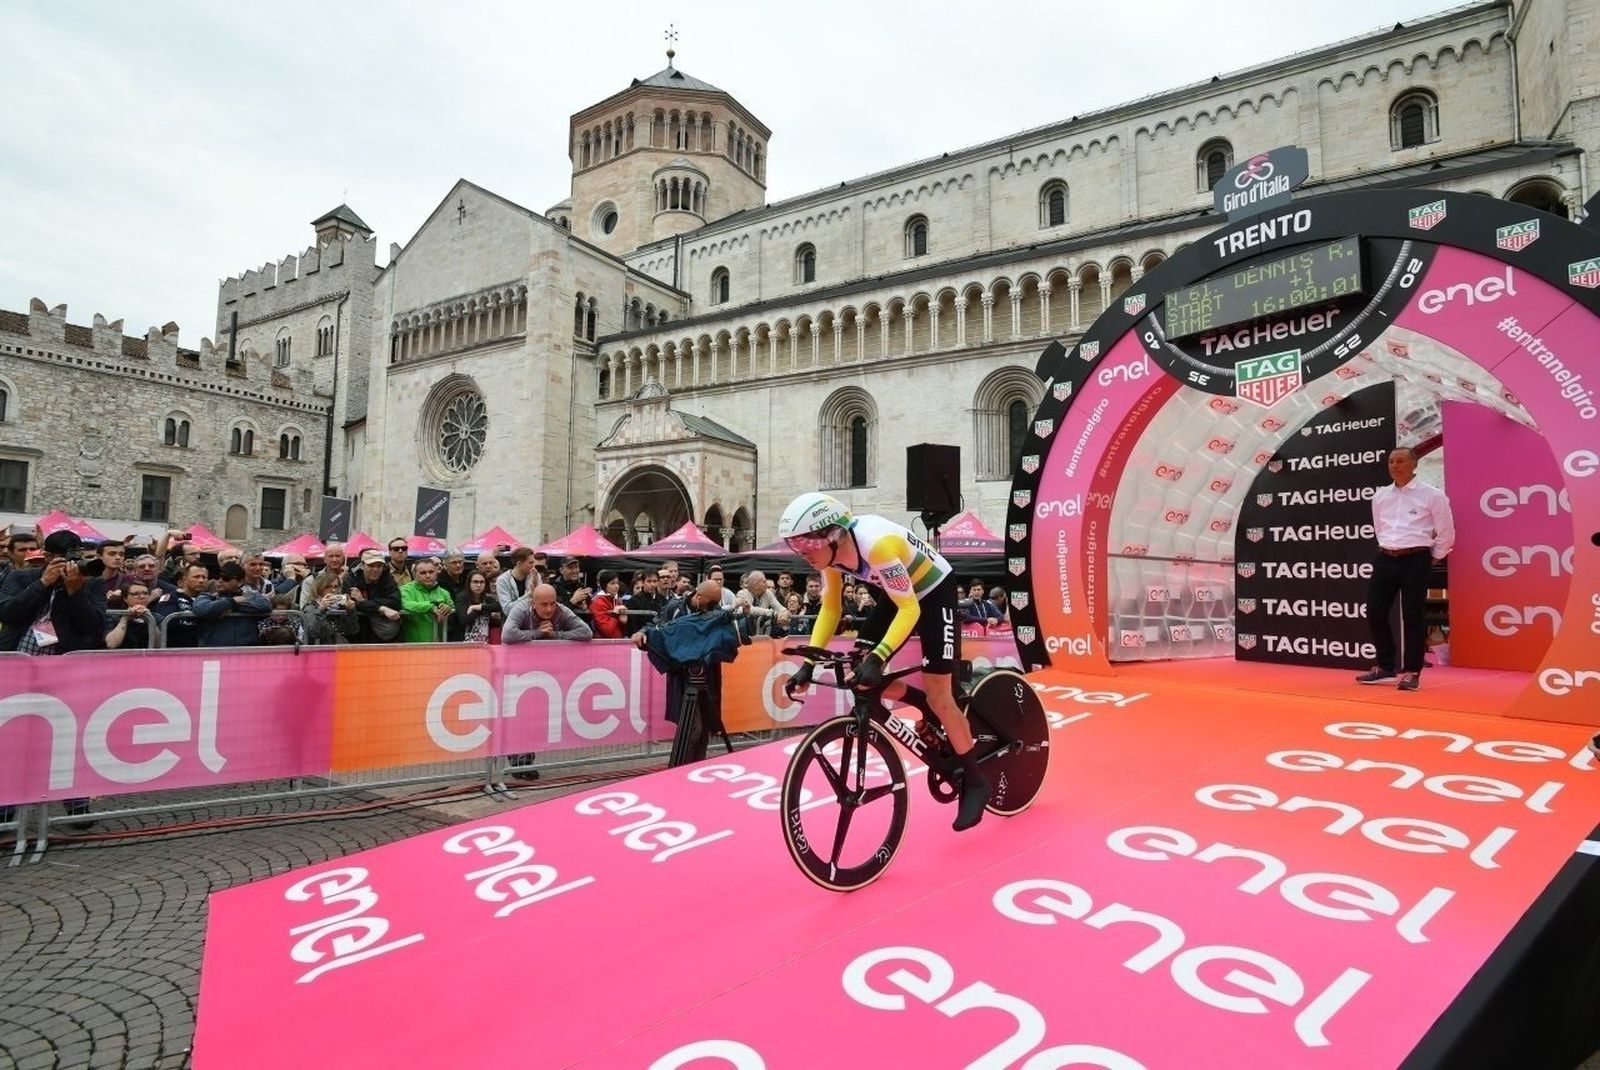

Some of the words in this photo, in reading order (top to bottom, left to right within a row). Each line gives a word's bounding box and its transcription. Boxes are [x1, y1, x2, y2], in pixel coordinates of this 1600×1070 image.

[1223, 188, 1249, 213] Giro
[1250, 174, 1290, 204] d'Italia
[1413, 202, 1444, 217] TAG
[1213, 209, 1312, 258] TRENTO
[1411, 213, 1444, 229] HEUER
[1501, 222, 1536, 235] TAG
[1499, 232, 1537, 250] HEUER
[1234, 252, 1313, 289] DENNIS
[1329, 243, 1354, 261] R.
[1571, 270, 1600, 287] HEU
[1572, 259, 1600, 273] TA
[1168, 294, 1224, 322] START
[1290, 271, 1314, 288] +1
[1169, 313, 1212, 337] TIME
[1252, 274, 1361, 317] 16:00:01
[1418, 266, 1517, 314] enel
[1201, 309, 1340, 356] TAGHeuer
[1098, 354, 1150, 387] enel
[1240, 354, 1295, 379] TAG
[1496, 316, 1598, 420] #entranelgiro
[1240, 375, 1298, 404] HEUER
[1065, 398, 1109, 478] #entranelgiro
[1315, 417, 1385, 435] TAGHeuer
[1287, 450, 1385, 471] TAGHeuer
[1036, 494, 1083, 519] enel
[1479, 484, 1573, 519] en
[906, 531, 937, 562] BMC
[1270, 524, 1375, 542] TAGHeue
[886, 565, 905, 578] TAG
[1056, 530, 1072, 614] #entranelgiro
[1262, 562, 1374, 579] TAGHeue
[1482, 544, 1575, 577] en
[1262, 599, 1367, 618] TAGHeu
[1483, 604, 1562, 639] en
[942, 607, 954, 660] BMC
[1045, 633, 1092, 656] enel
[1263, 635, 1377, 659] TAGHeue
[1538, 667, 1600, 696] en
[425, 648, 648, 753] enel
[0, 660, 227, 791] nel
[884, 715, 928, 756] BMC
[1323, 721, 1597, 771] enel
[1266, 750, 1566, 814] enel
[575, 791, 735, 863] enel
[1194, 783, 1518, 869] enel
[443, 825, 596, 917] enel
[1106, 825, 1456, 944] enel
[284, 867, 425, 983] enel
[992, 879, 1374, 1047] enel
[842, 946, 1150, 1070] en
